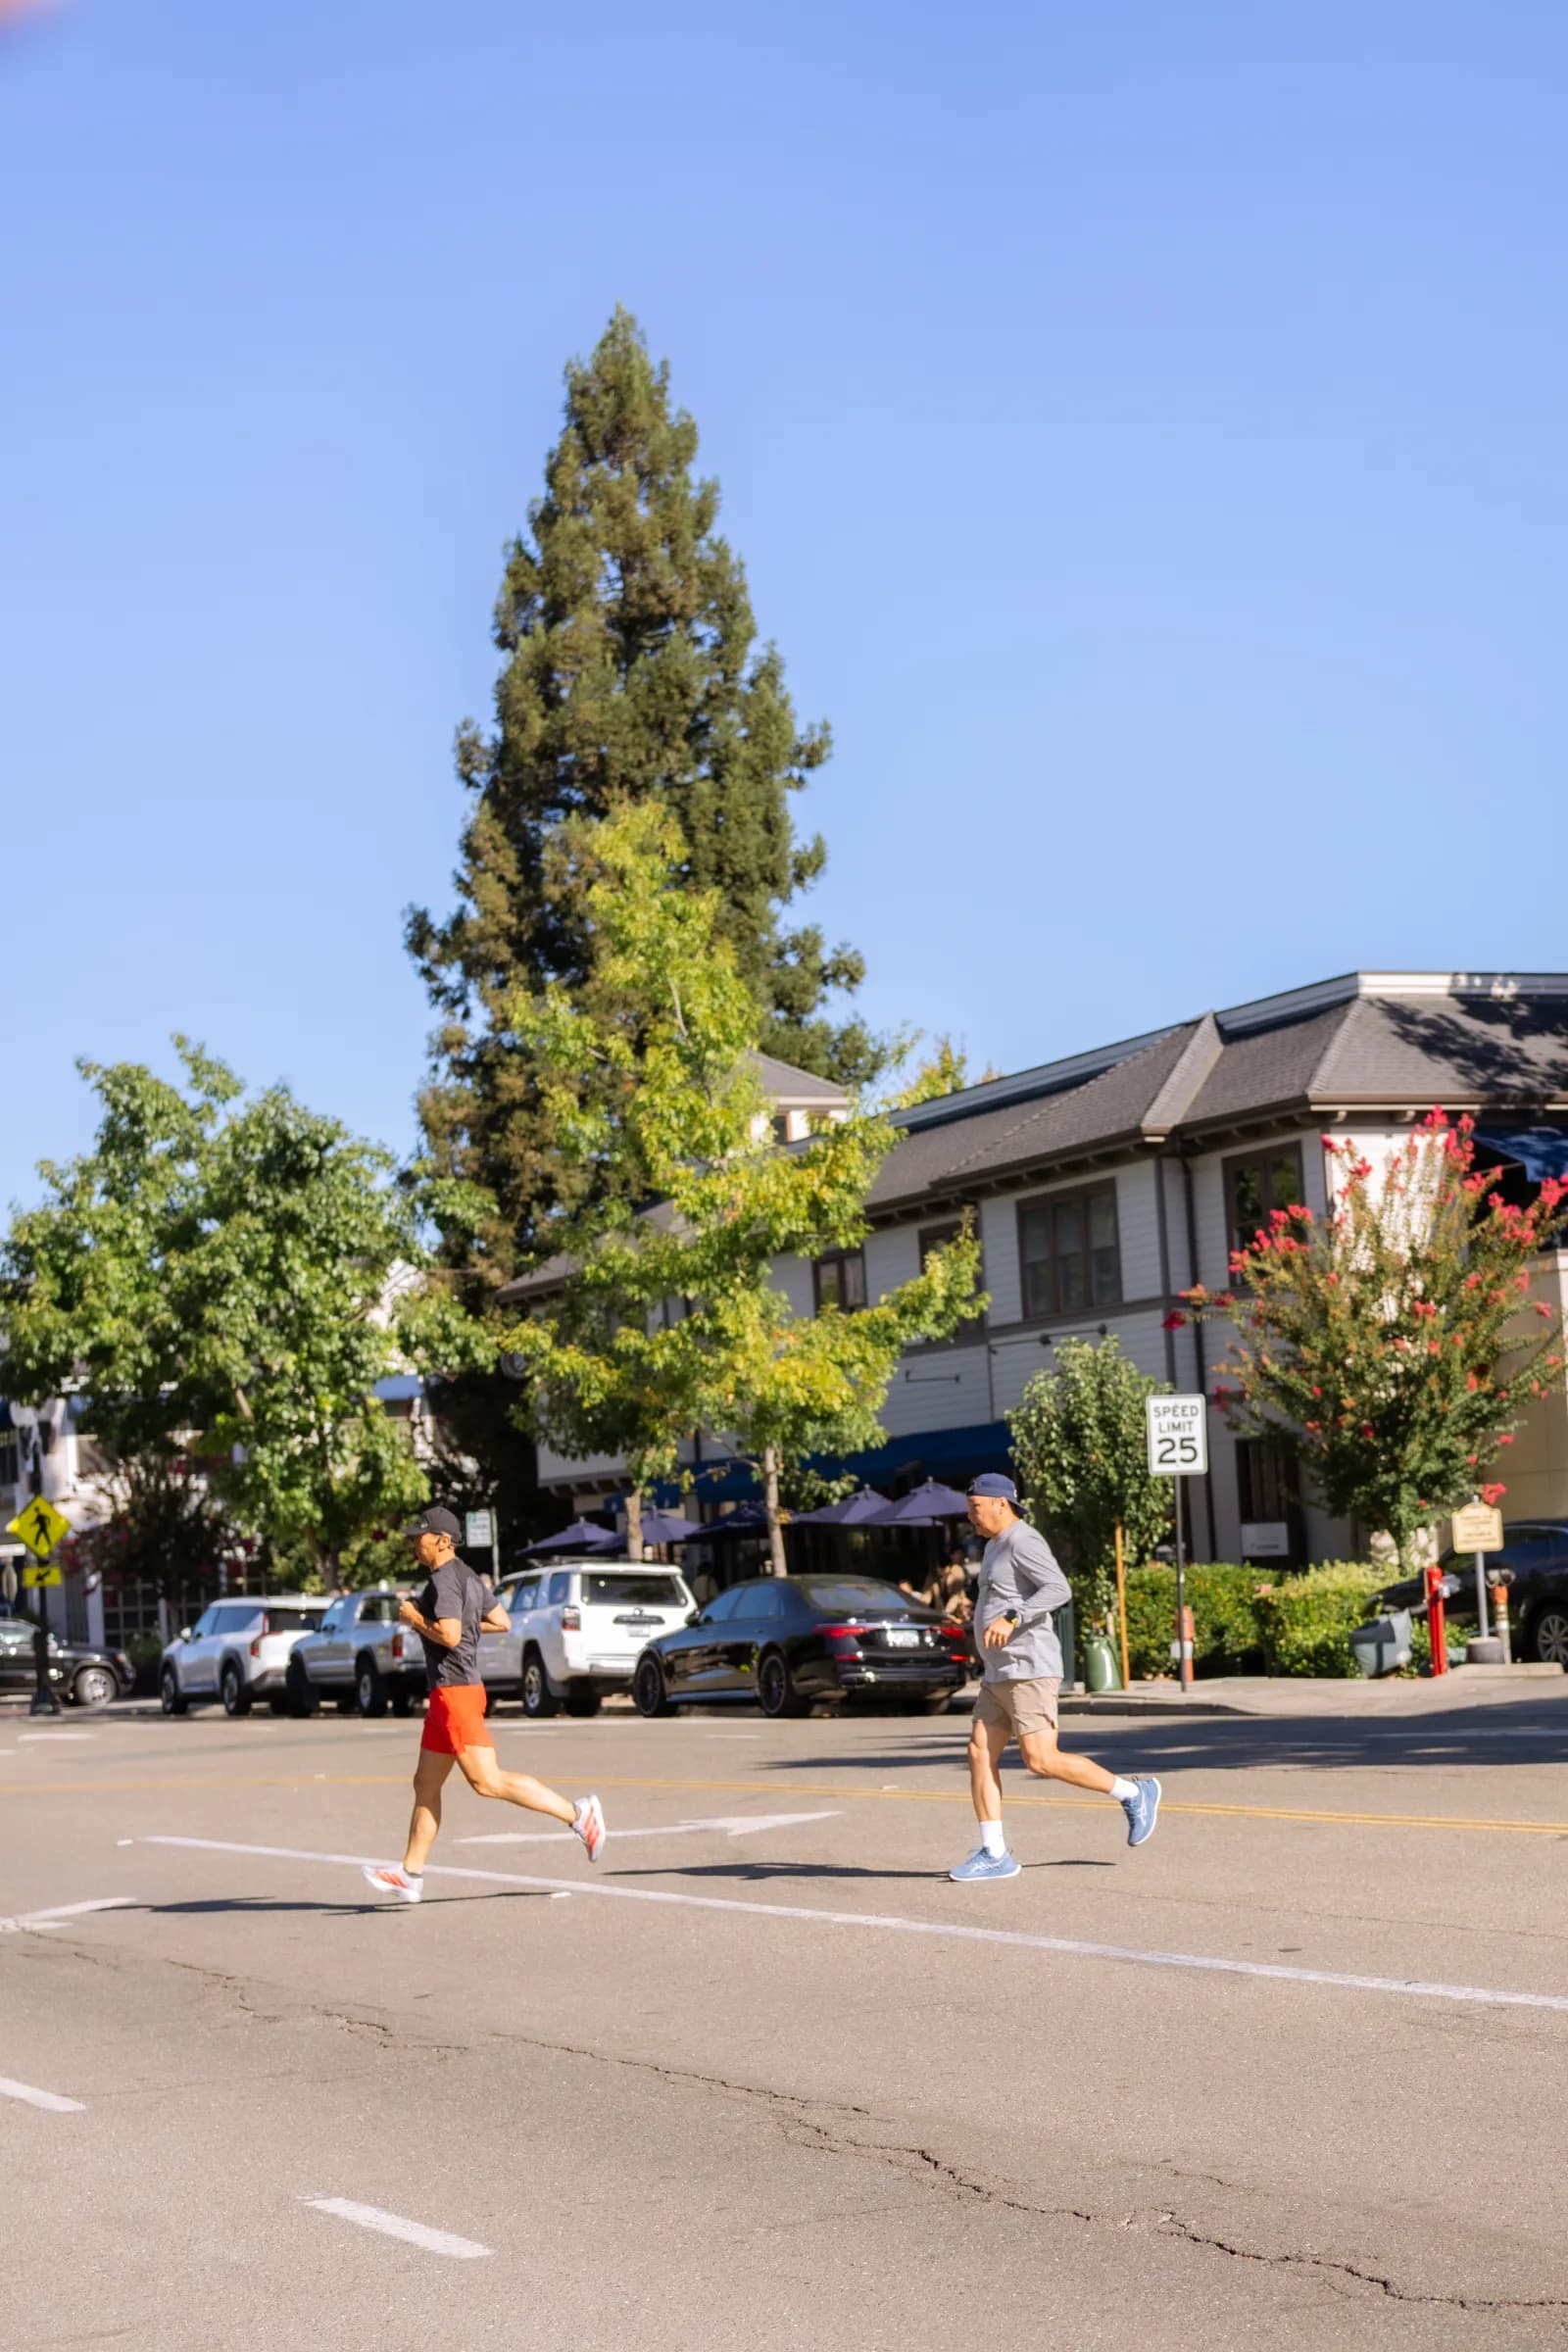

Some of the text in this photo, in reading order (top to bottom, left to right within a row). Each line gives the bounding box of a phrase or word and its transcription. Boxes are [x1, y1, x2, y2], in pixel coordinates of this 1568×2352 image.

[1153, 1404, 1199, 1417] SPEED
[1158, 1420, 1193, 1433] LIMIT
[1157, 1437, 1198, 1463] 25
